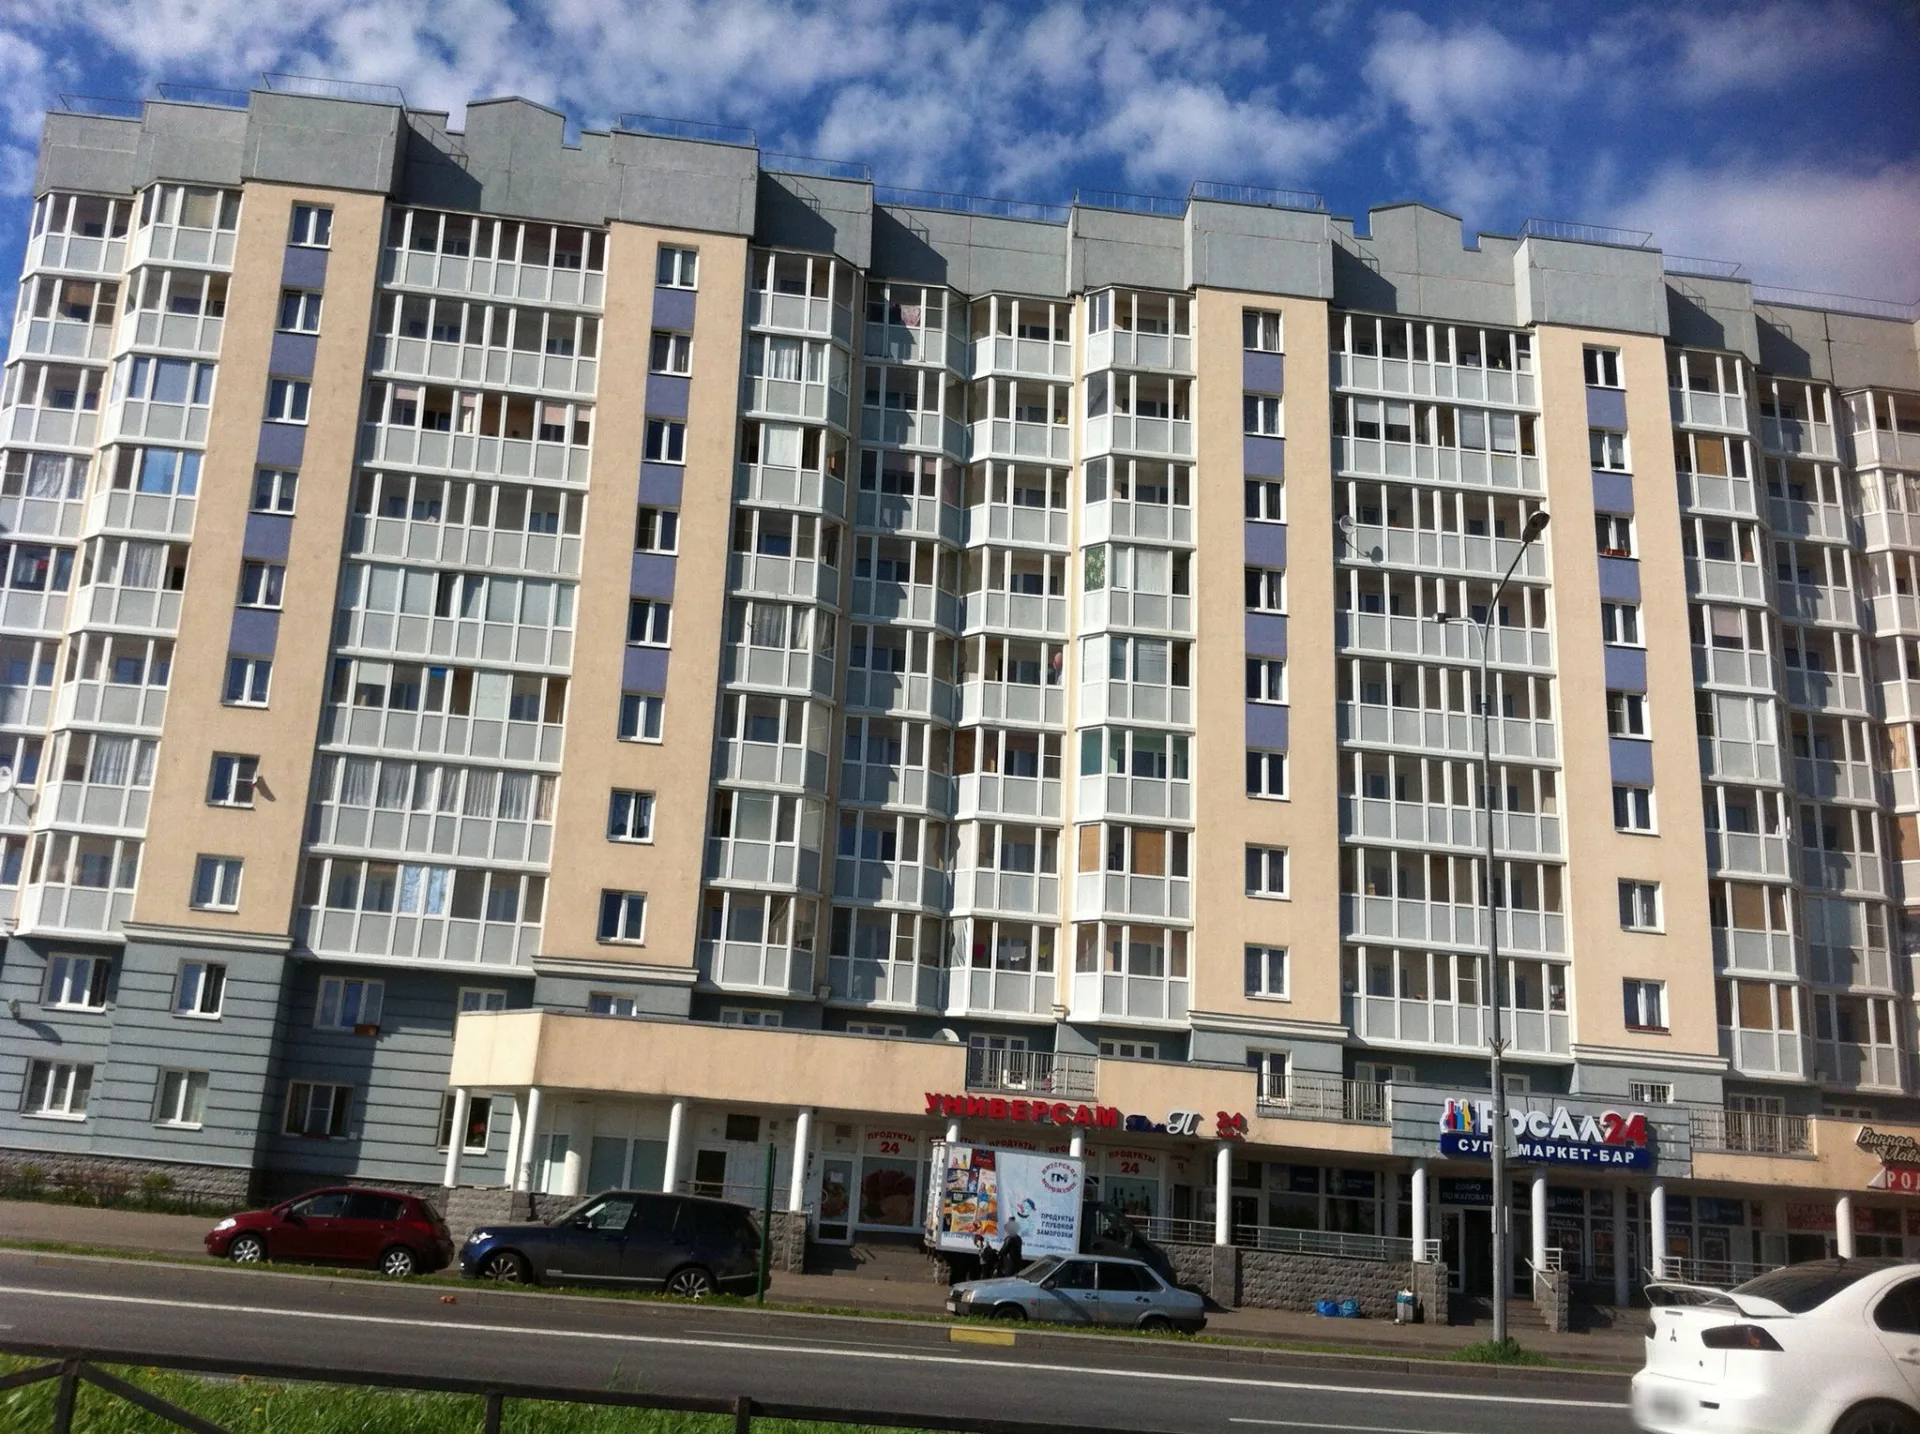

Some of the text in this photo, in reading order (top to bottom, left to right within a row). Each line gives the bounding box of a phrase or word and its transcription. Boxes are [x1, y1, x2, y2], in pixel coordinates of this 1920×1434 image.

[925, 1092, 1118, 1128] УНИВЕРСАМ
[867, 1131, 916, 1143] ПРОДУКТЫ
[1858, 1128, 1914, 1148] Винная
[880, 1141, 900, 1154] 24
[1458, 1138, 1635, 1164] СУПМАРКЕТ-БАР
[1108, 1150, 1156, 1163] ПРОДУКТЫ
[1120, 1162, 1141, 1174] 24
[1041, 1212, 1075, 1223] ПРОДУКТЫ
[1041, 1221, 1074, 1231] ГЛУБОКОЙ
[1036, 1229, 1074, 1239] ЗАМОРОЗКИ
